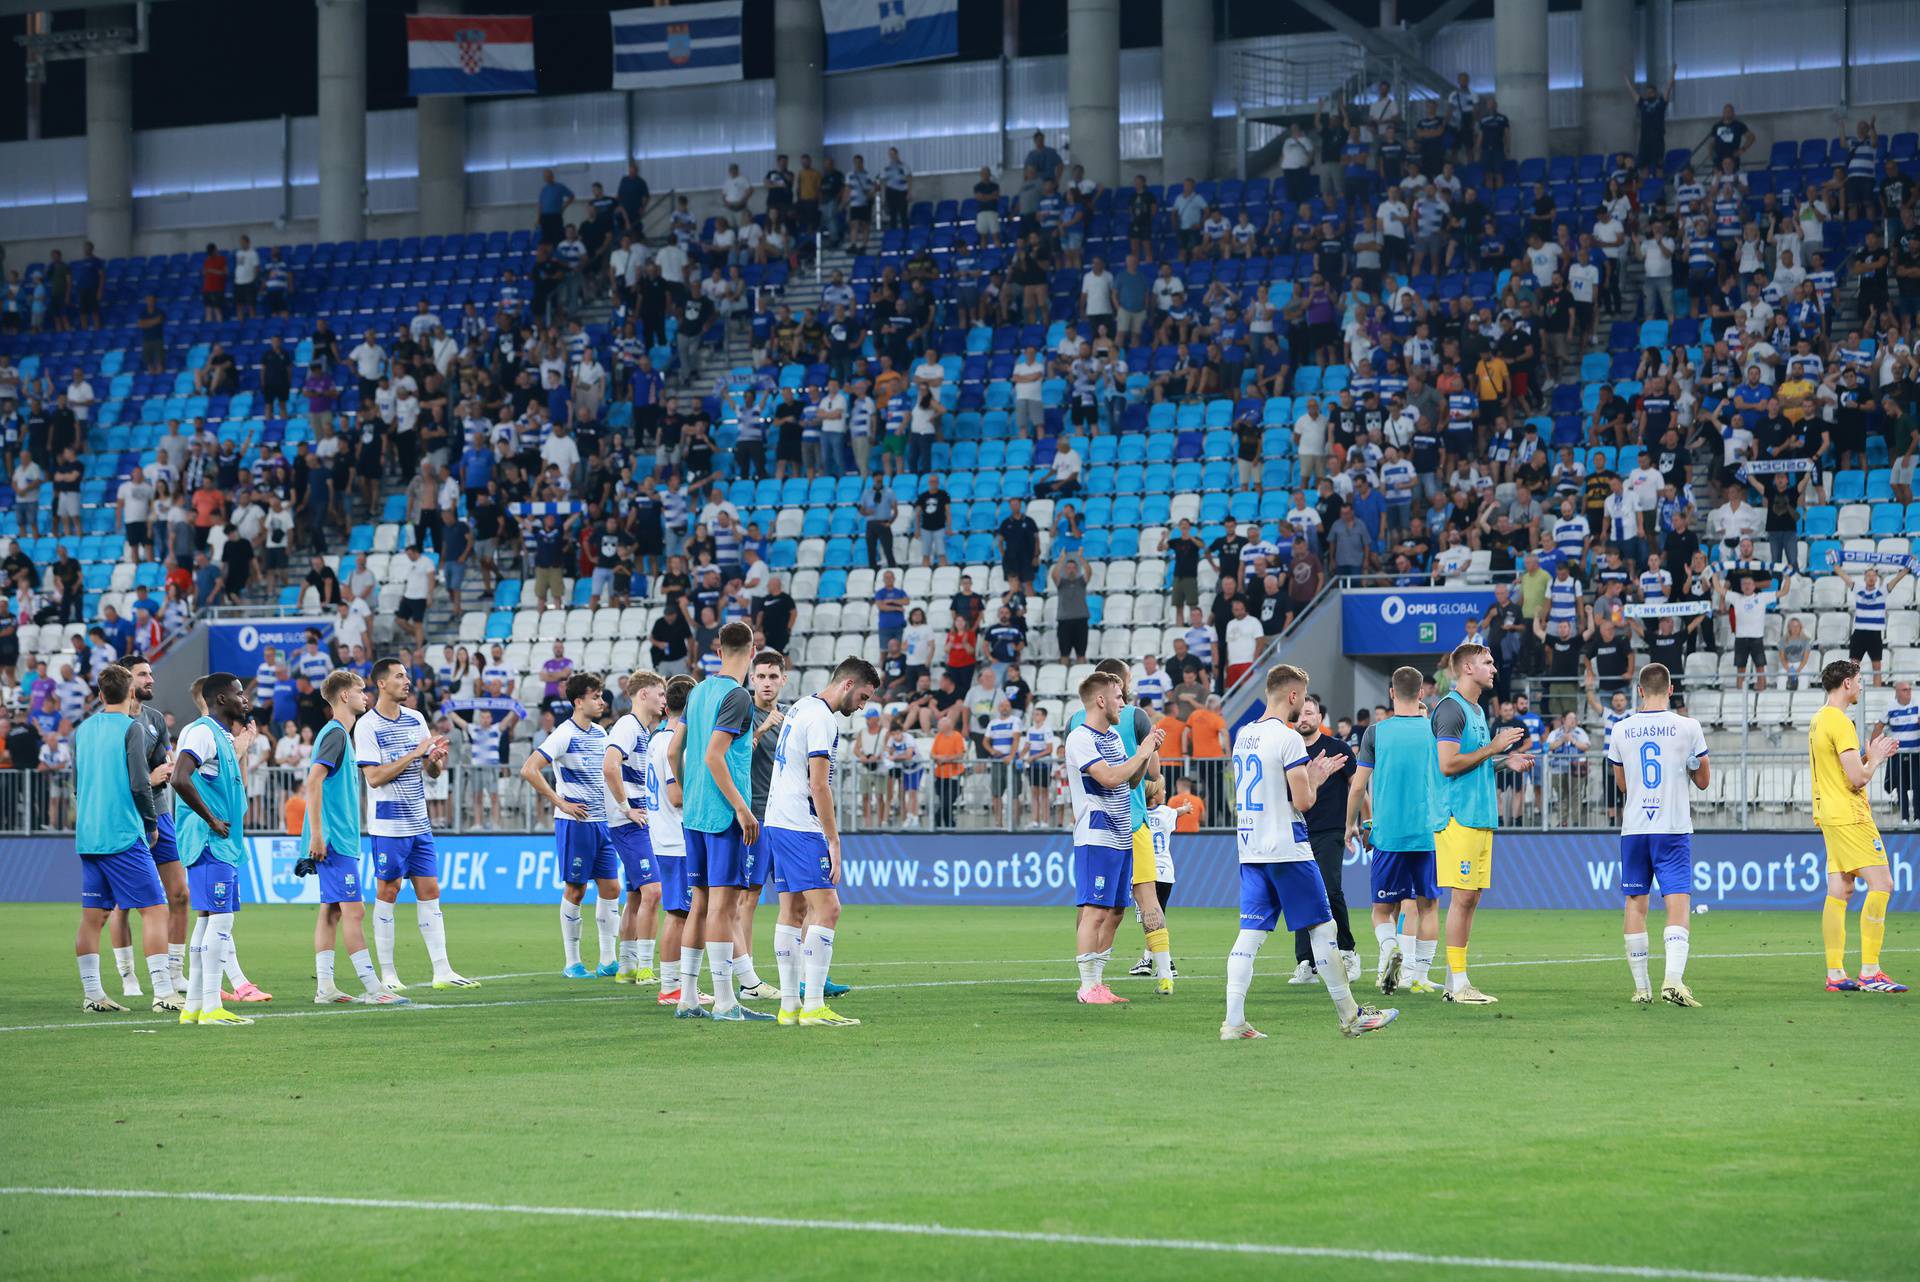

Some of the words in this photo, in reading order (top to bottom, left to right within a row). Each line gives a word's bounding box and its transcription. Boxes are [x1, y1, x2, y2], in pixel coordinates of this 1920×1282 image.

[1407, 603, 1437, 615] OPUS
[1439, 603, 1479, 615] GLOBAL
[1644, 606, 1657, 614] NK
[260, 633, 284, 643] OPUS
[774, 724, 792, 776] 4
[1624, 725, 1677, 739] NEJAŠMIĆ
[646, 763, 660, 812] 9
[1232, 754, 1264, 811] 22
[1640, 741, 1662, 789] 6
[843, 851, 1076, 896] www.sport36
